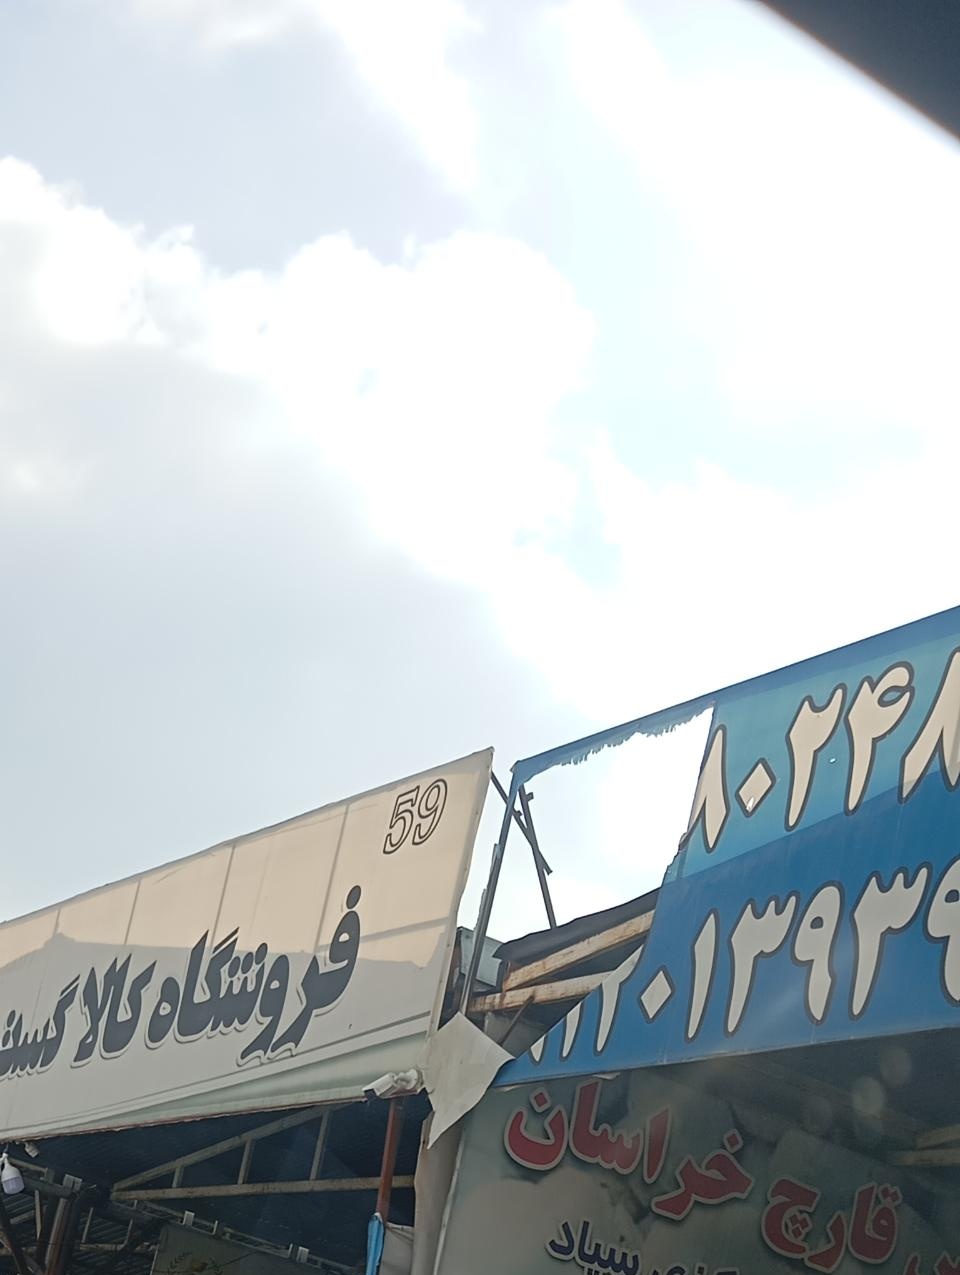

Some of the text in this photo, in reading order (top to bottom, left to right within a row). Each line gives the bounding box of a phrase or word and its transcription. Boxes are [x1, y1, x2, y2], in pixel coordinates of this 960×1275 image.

[382, 777, 448, 855] 59
[71, 952, 157, 1069] کالا
[144, 884, 361, 1068] فروشگاه
[503, 1078, 902, 1274] قارچ خراسان
